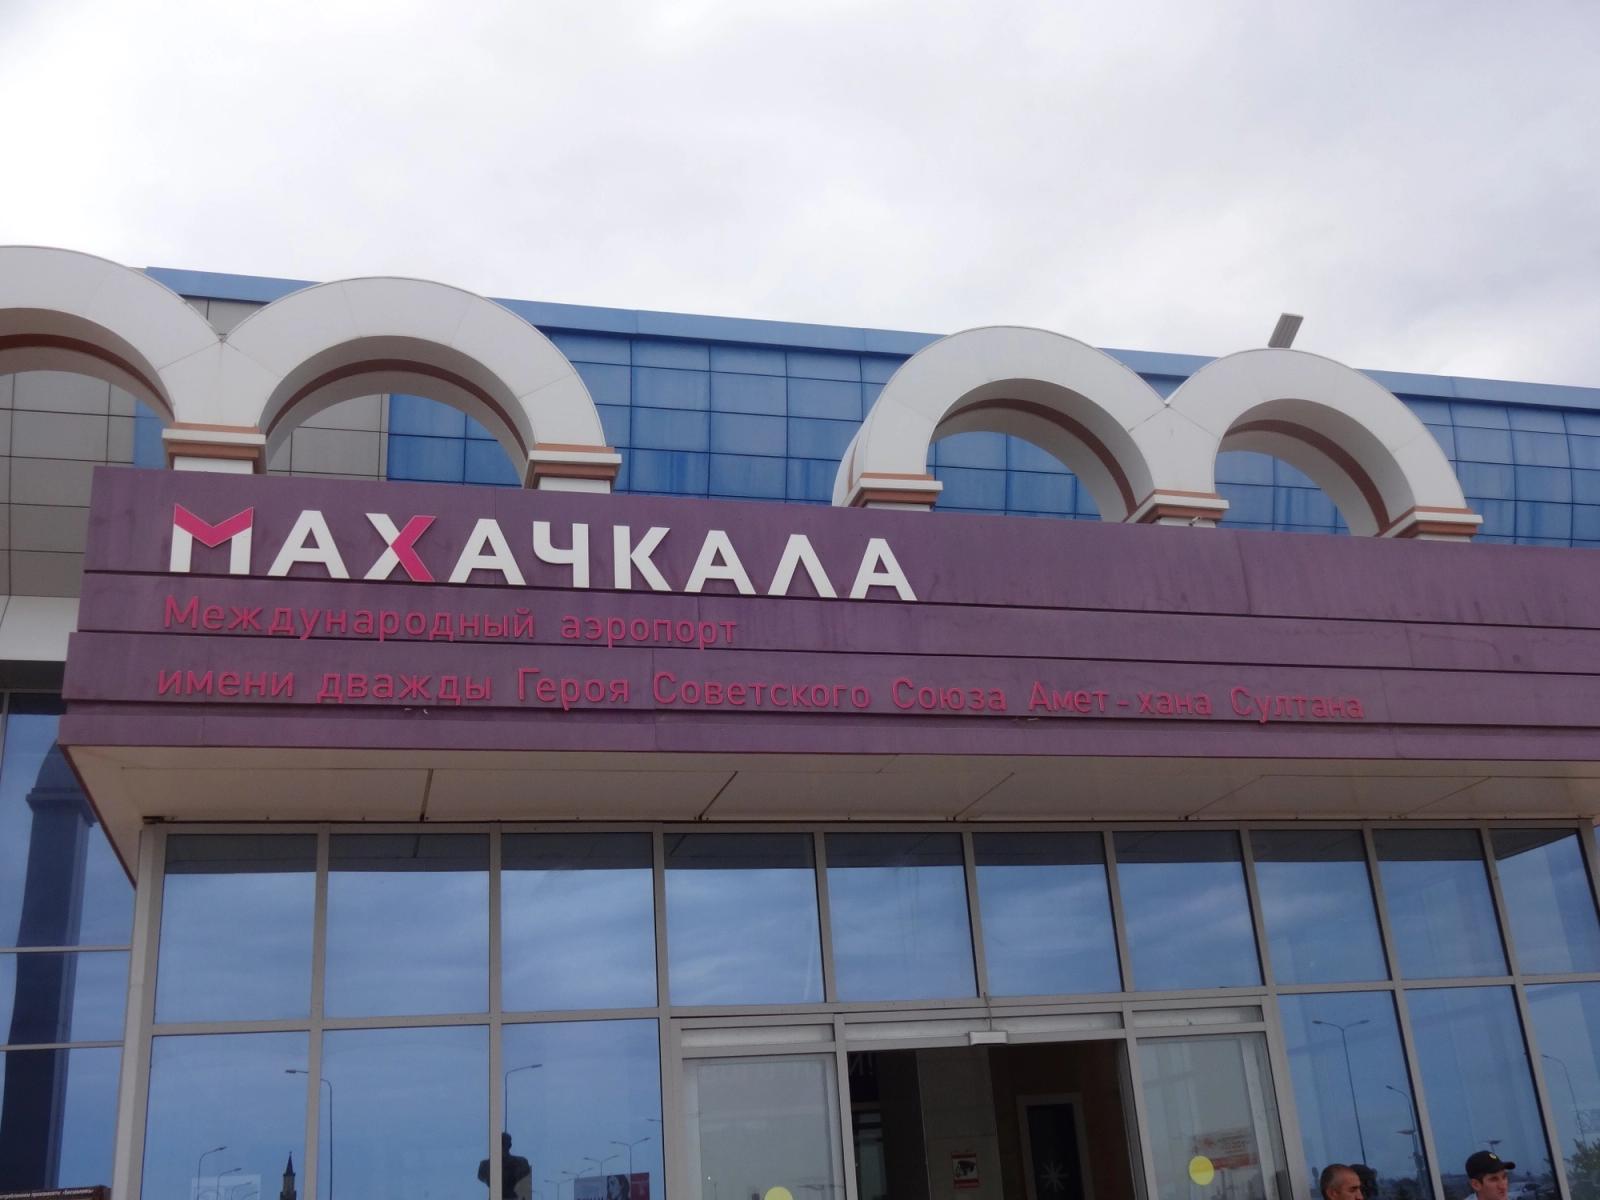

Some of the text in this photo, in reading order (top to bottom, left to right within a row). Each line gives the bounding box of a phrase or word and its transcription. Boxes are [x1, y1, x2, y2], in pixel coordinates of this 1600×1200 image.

[169, 503, 918, 602] МАХАЧКАЛА
[163, 595, 738, 650] Международный аэропорт
[157, 670, 296, 698] имени
[316, 671, 493, 705] дважды
[518, 667, 630, 711] Героя
[652, 671, 871, 710] Советского
[891, 676, 1007, 712] Союза
